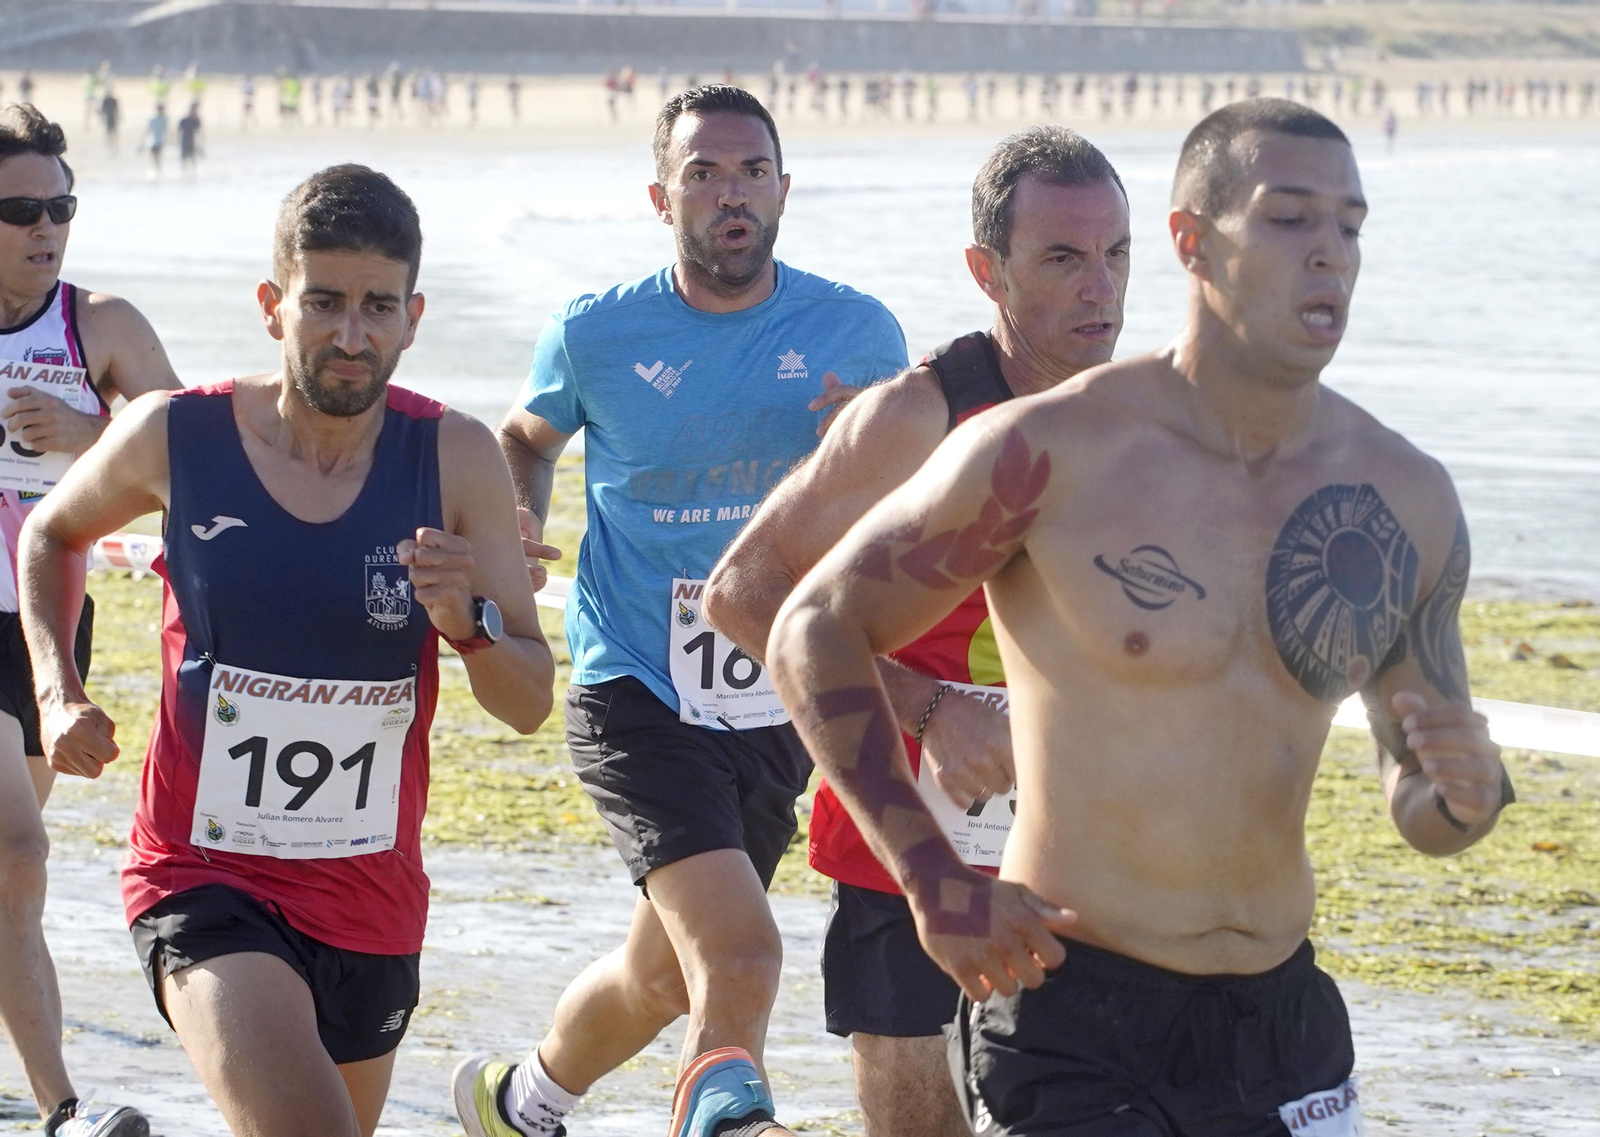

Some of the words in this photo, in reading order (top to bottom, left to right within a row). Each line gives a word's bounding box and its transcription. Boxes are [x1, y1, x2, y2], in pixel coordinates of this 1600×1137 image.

[31, 368, 83, 386] AREA
[777, 370, 808, 380] luanvi
[653, 508, 675, 523] WE
[680, 508, 711, 523] ARE
[375, 545, 395, 554] CLU
[367, 617, 409, 631] ATLETISMO
[212, 670, 339, 705] NIGRÁN
[337, 681, 413, 706] AREA
[228, 735, 376, 811] 191
[257, 812, 280, 822] Julian
[282, 815, 314, 823] Romero
[315, 815, 343, 824] Alvarez
[967, 820, 982, 829] José
[984, 822, 1011, 831] Antonio
